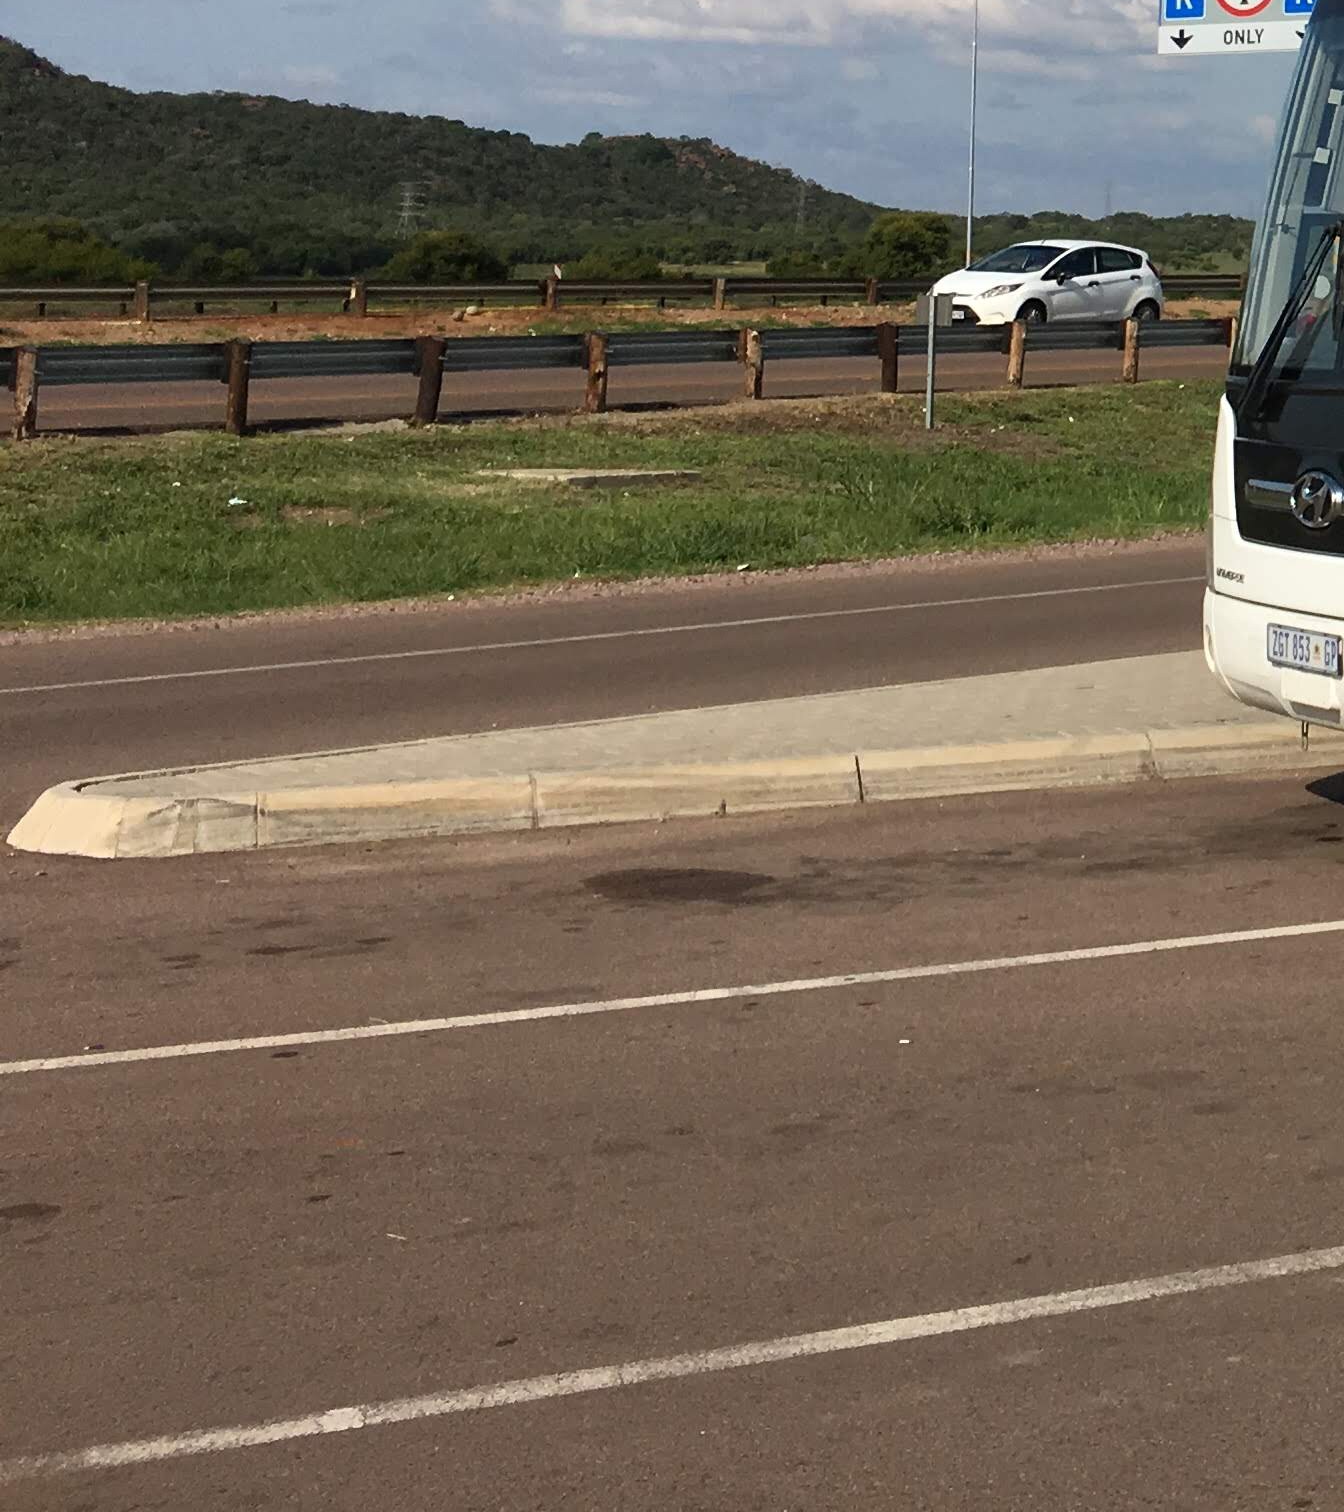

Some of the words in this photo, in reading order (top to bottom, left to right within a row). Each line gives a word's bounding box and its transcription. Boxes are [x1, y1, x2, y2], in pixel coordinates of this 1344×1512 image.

[1223, 28, 1265, 45] ONLY
[1272, 629, 1290, 658] ZGT
[1292, 633, 1311, 663] 853
[1324, 639, 1337, 666] GP
